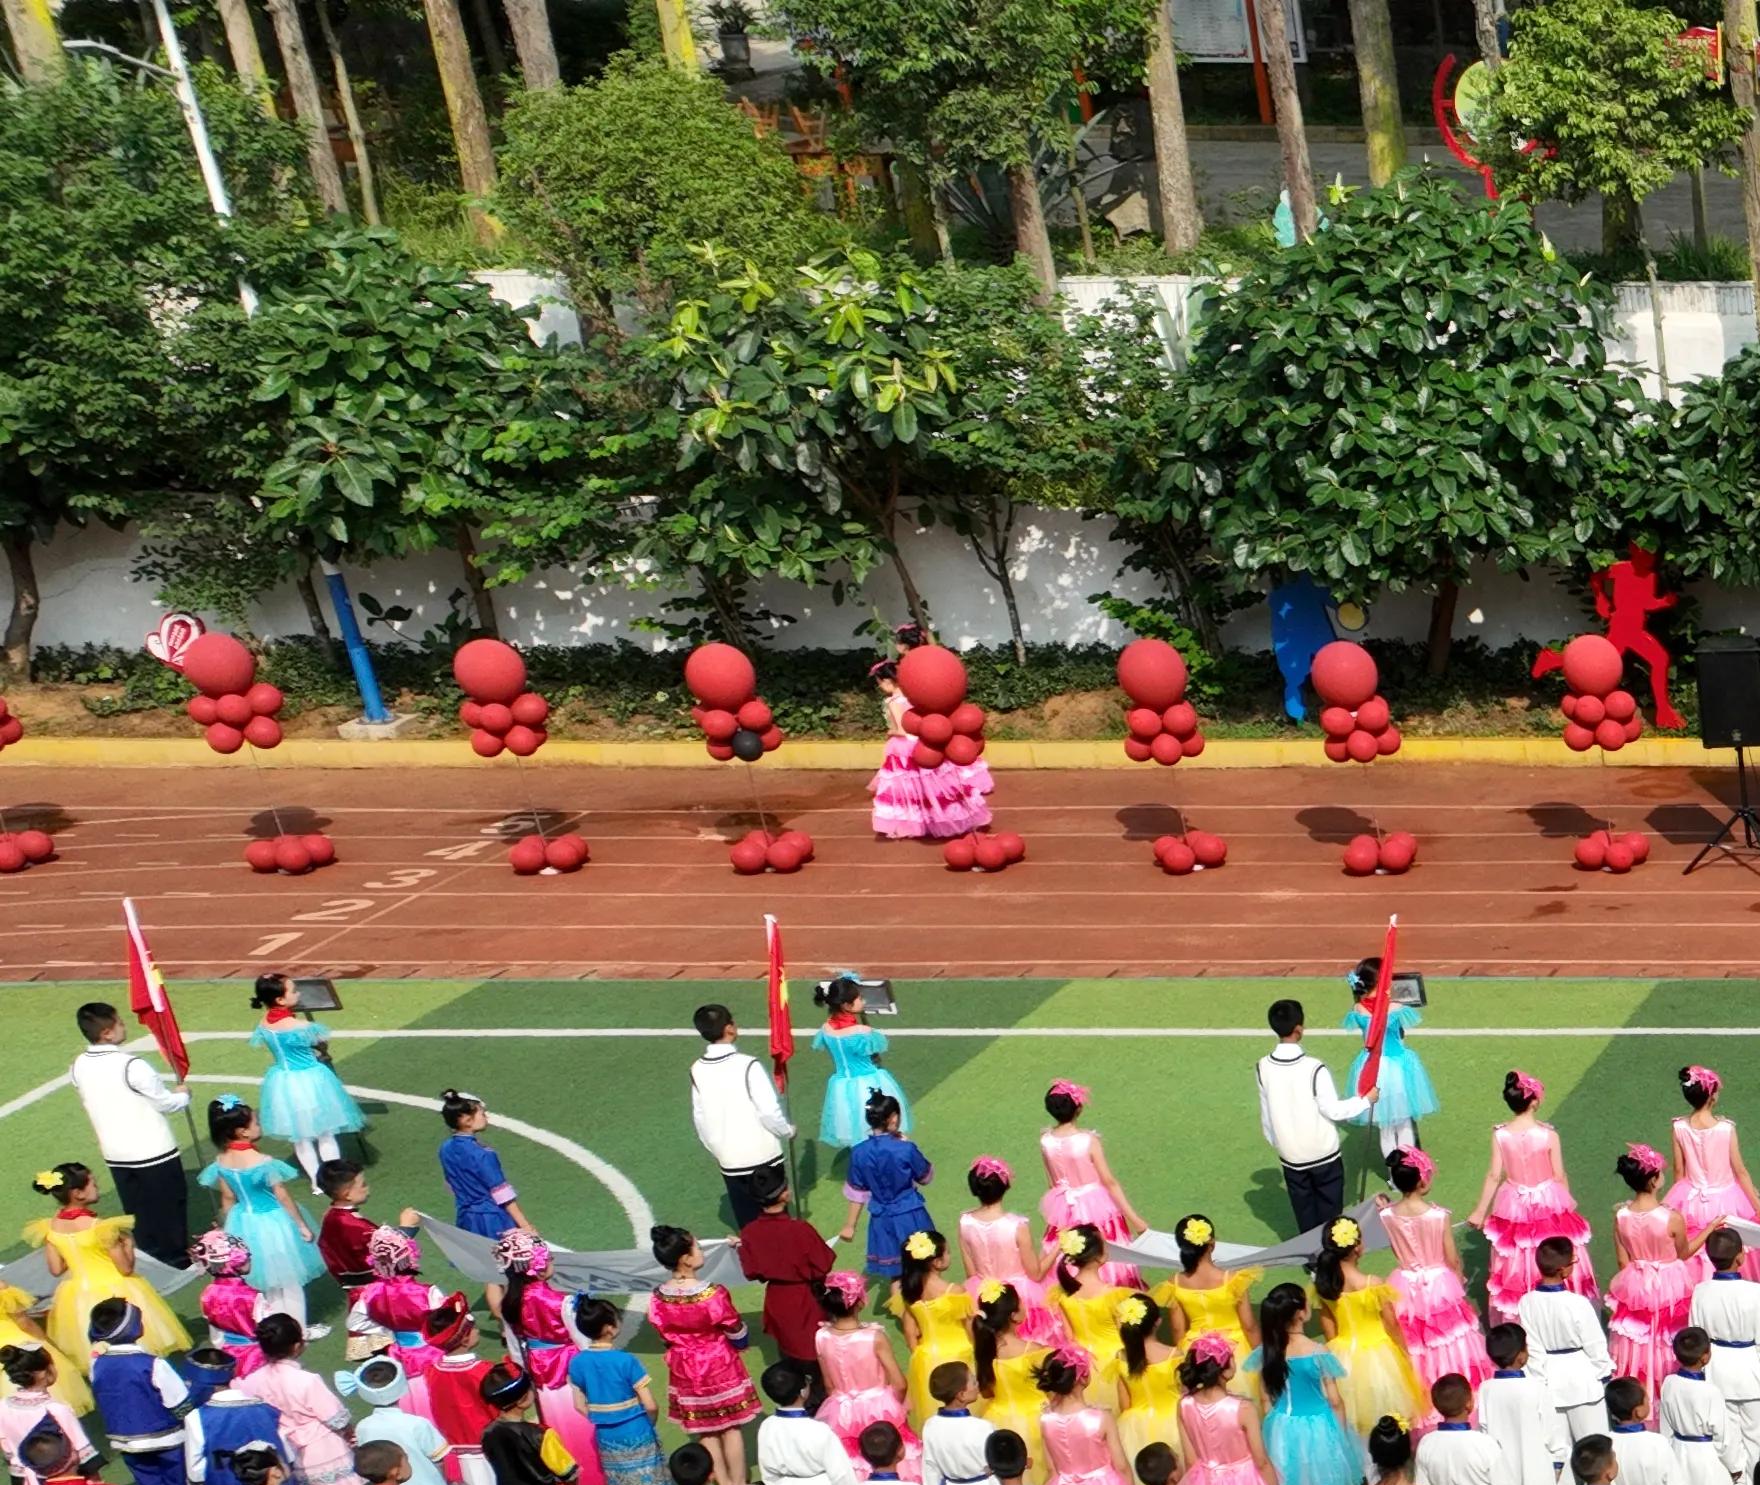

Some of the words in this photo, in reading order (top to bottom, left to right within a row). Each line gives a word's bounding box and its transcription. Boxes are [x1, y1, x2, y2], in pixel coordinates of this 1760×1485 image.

[423, 840, 494, 860] 4
[362, 867, 438, 889] 3
[290, 898, 376, 921] 2
[248, 931, 305, 956] 1
